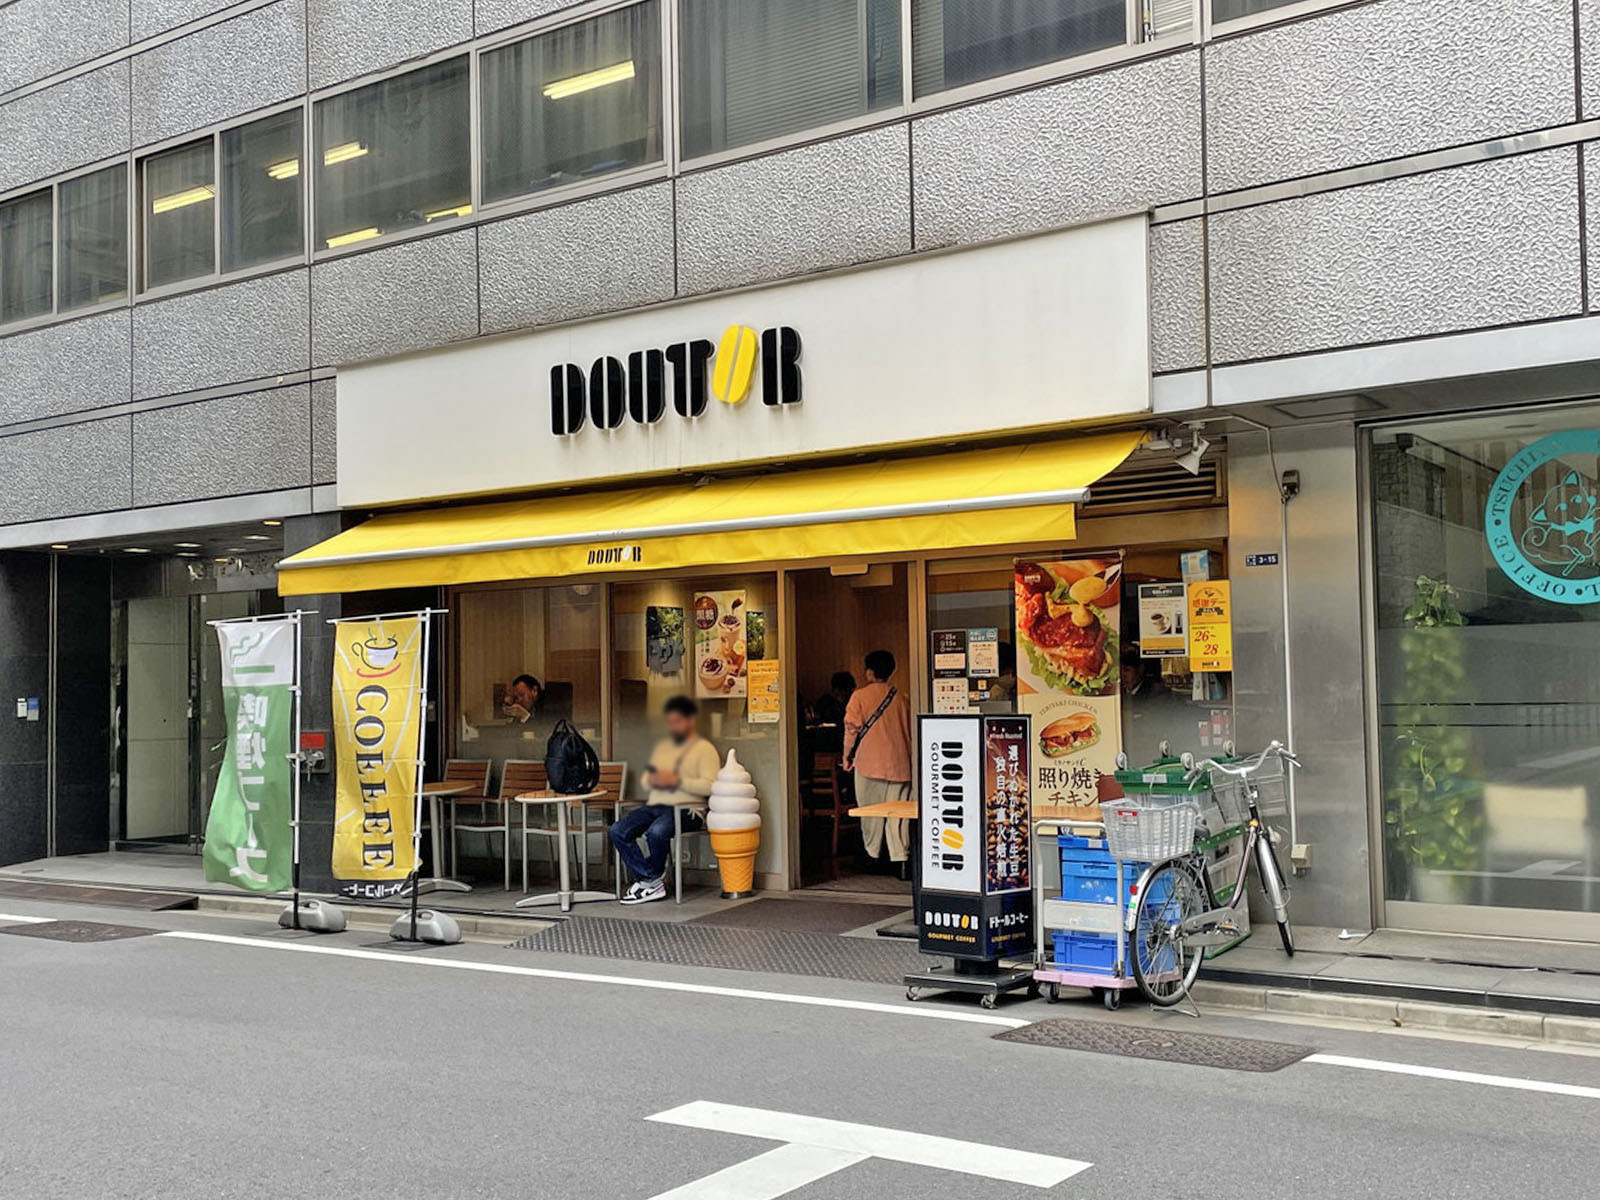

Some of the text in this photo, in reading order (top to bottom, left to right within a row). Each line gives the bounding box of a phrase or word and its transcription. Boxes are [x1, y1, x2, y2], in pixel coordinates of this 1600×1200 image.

[550, 324, 804, 436] DOUTOR
[587, 544, 642, 566] DOUTOR
[1494, 534, 1566, 597] OFFICE
[1203, 643, 1219, 656] 28
[930, 742, 940, 869] GOURMET COFFEE
[941, 742, 965, 873] DOUTOR
[925, 910, 979, 930] DOUTOR
[989, 912, 1029, 929] ドトールコーヒー
